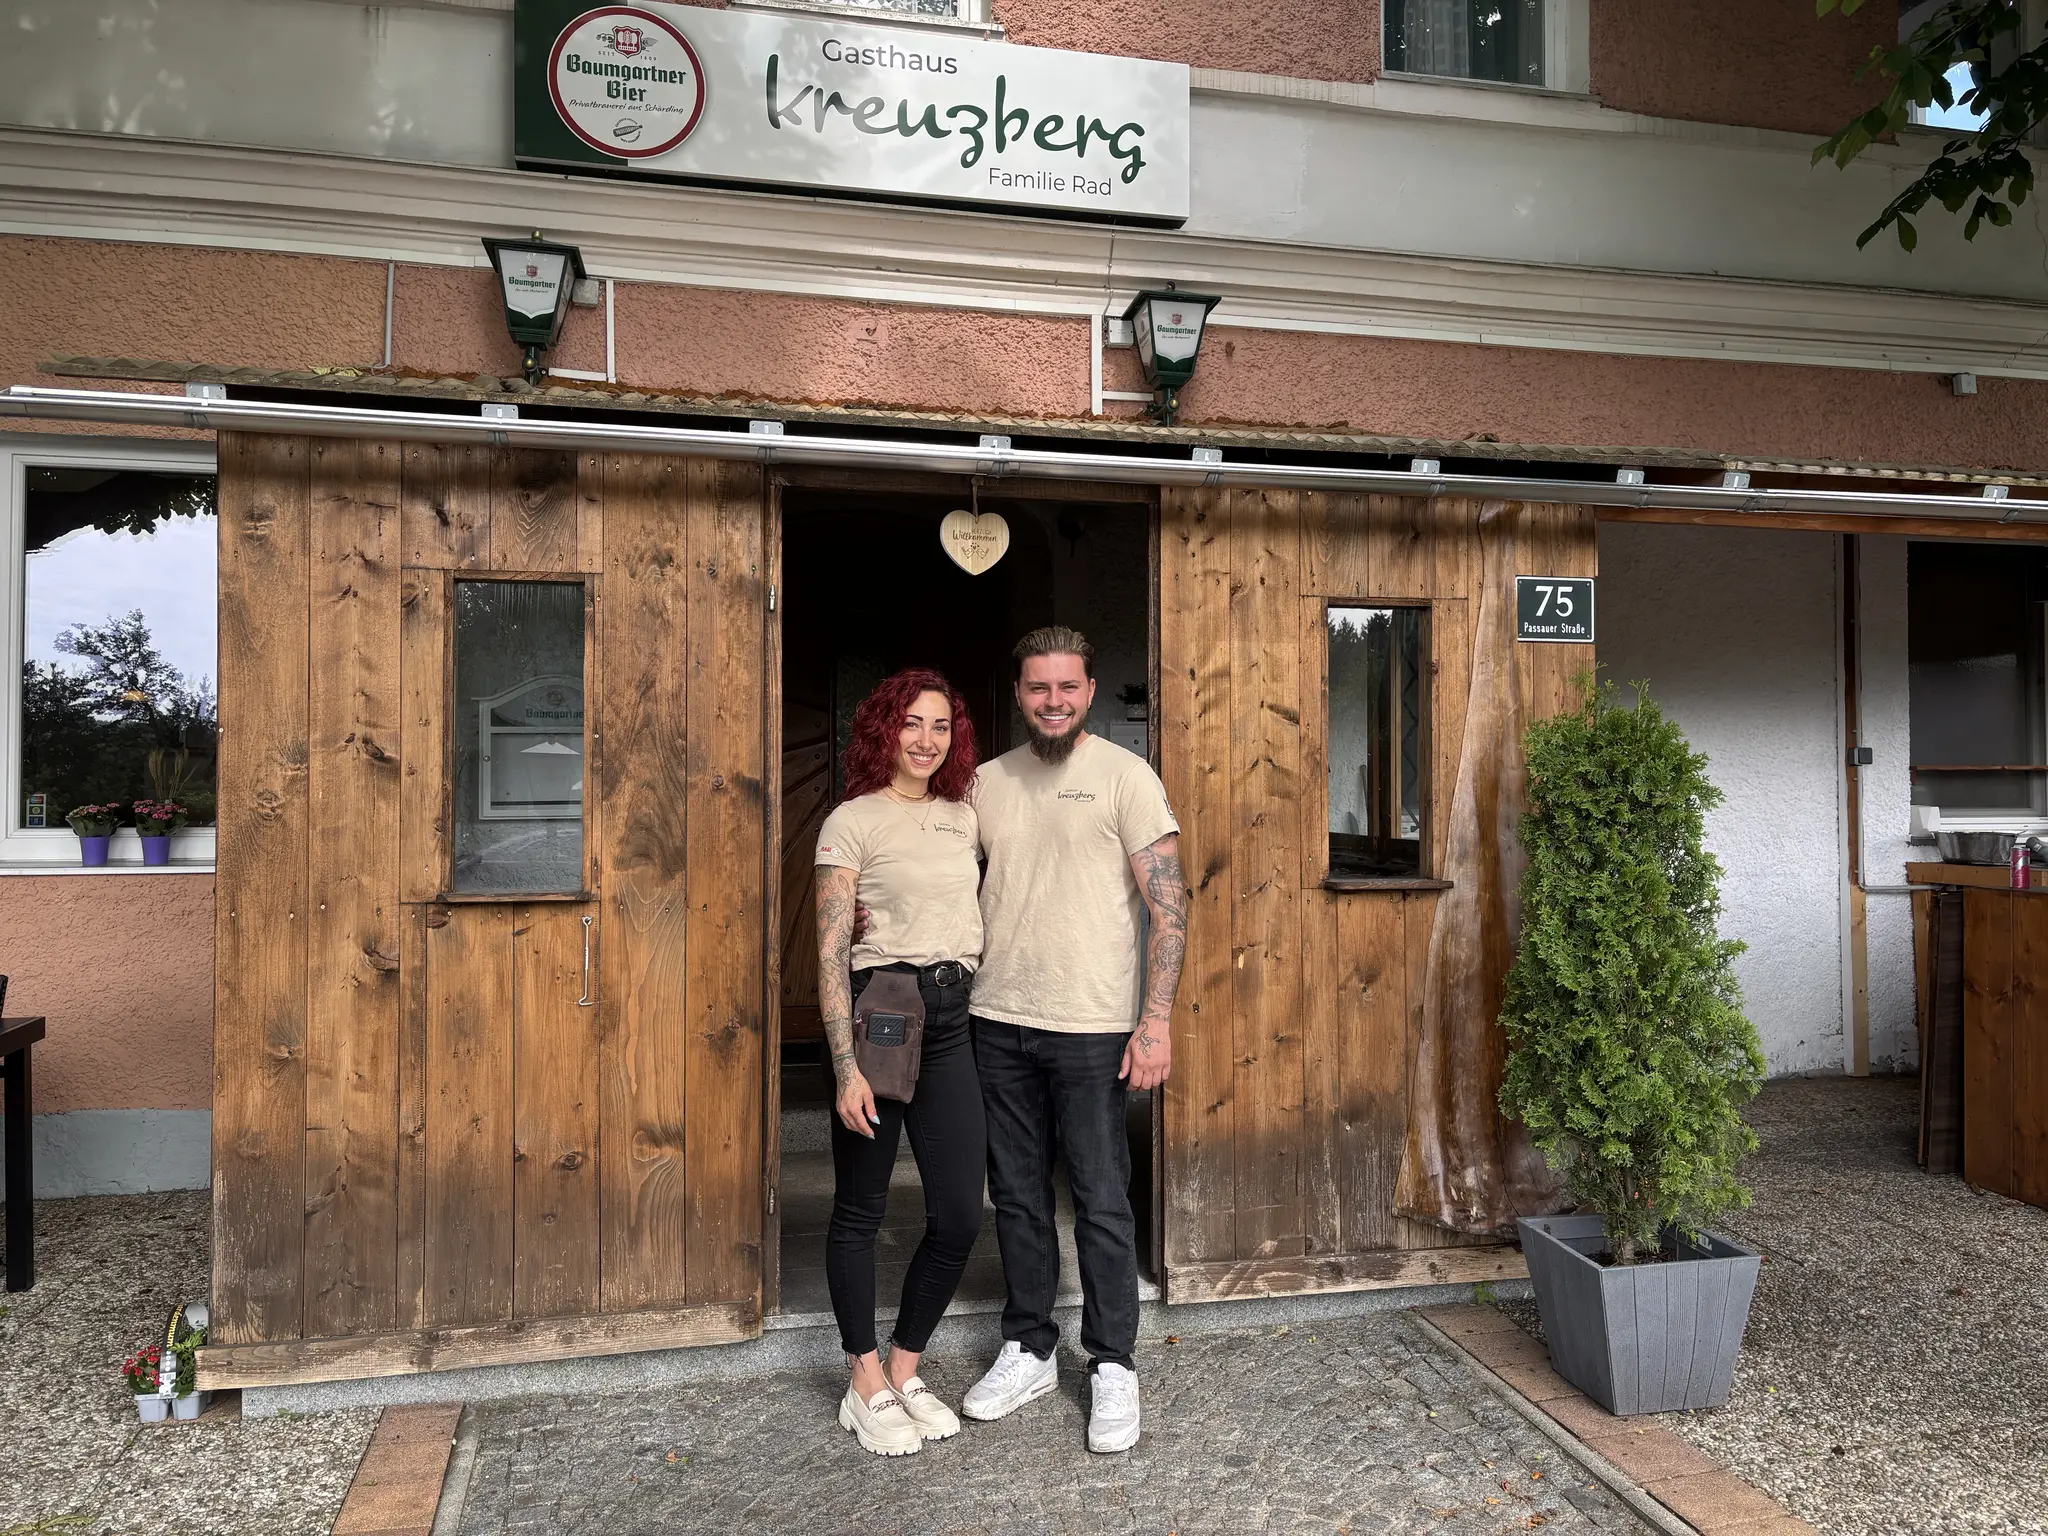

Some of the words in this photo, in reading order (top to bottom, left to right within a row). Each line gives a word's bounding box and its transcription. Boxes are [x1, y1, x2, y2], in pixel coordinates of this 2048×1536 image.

[822, 38, 958, 75] Gasthaus
[566, 53, 687, 85] Baumgartner
[606, 79, 648, 102] Bier
[568, 98, 627, 111] Privatbrauerei
[627, 104, 643, 112] aus
[766, 53, 1147, 185] kreuzberg
[989, 166, 1066, 192] Familie
[1072, 175, 1112, 196] Rad
[508, 276, 557, 289] Baumgartner
[1157, 324, 1198, 335] Baumgartner
[952, 529, 997, 543] Willkommen
[1535, 585, 1574, 617] 75
[1524, 621, 1558, 633] Passauer
[1561, 622, 1586, 634] Straße
[525, 707, 584, 720] Baumgartne
